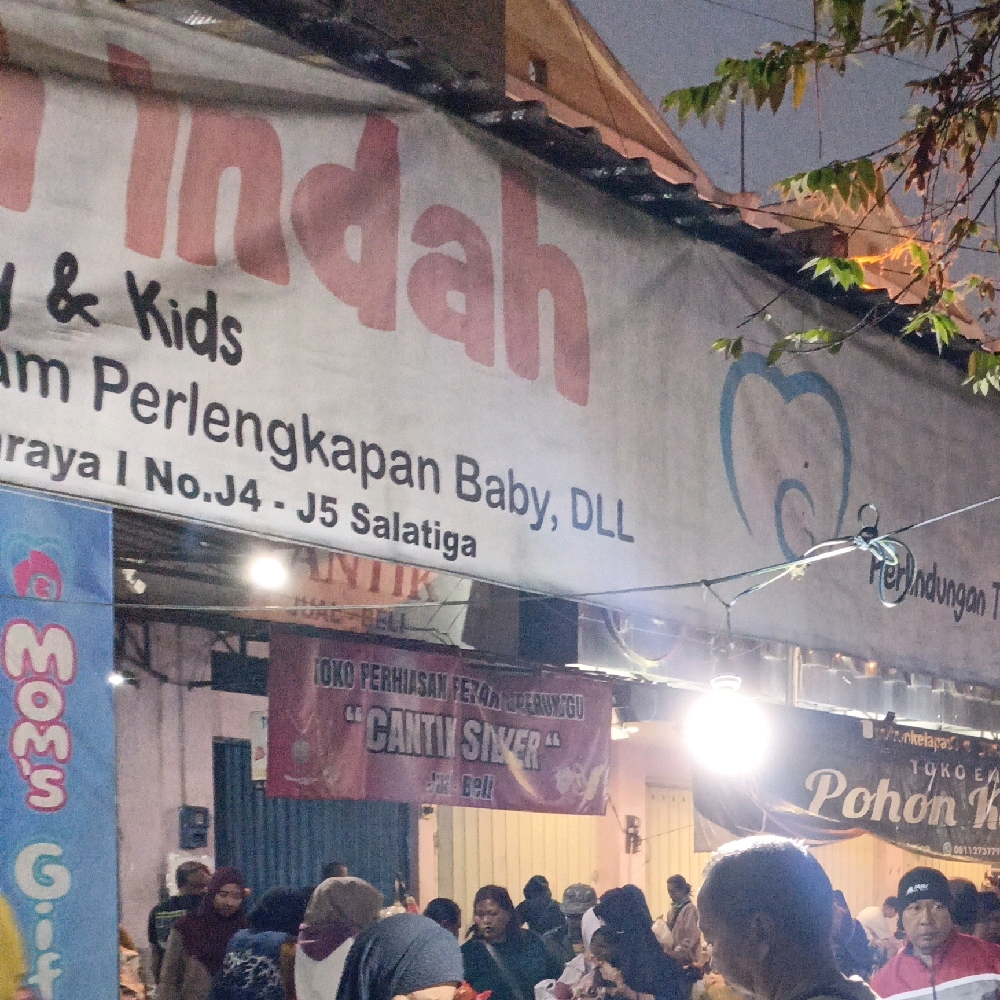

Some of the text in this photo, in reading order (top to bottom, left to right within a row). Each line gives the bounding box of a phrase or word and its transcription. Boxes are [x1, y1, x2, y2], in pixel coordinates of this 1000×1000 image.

[107, 43, 590, 406] Indah
[46, 251, 100, 327] &
[125, 270, 243, 366] Kids
[0, 433, 101, 482] raya
[145, 456, 262, 513] No.J4
[296, 491, 338, 528] J5
[351, 503, 477, 562] Salatiga
[93, 355, 441, 495] Perlengkapan
[455, 453, 559, 533] Baby,
[571, 486, 635, 544] DLL
[869, 552, 986, 622] Perlndungan
[804, 768, 958, 826] Pohon
[909, 759, 967, 780] TOKO
